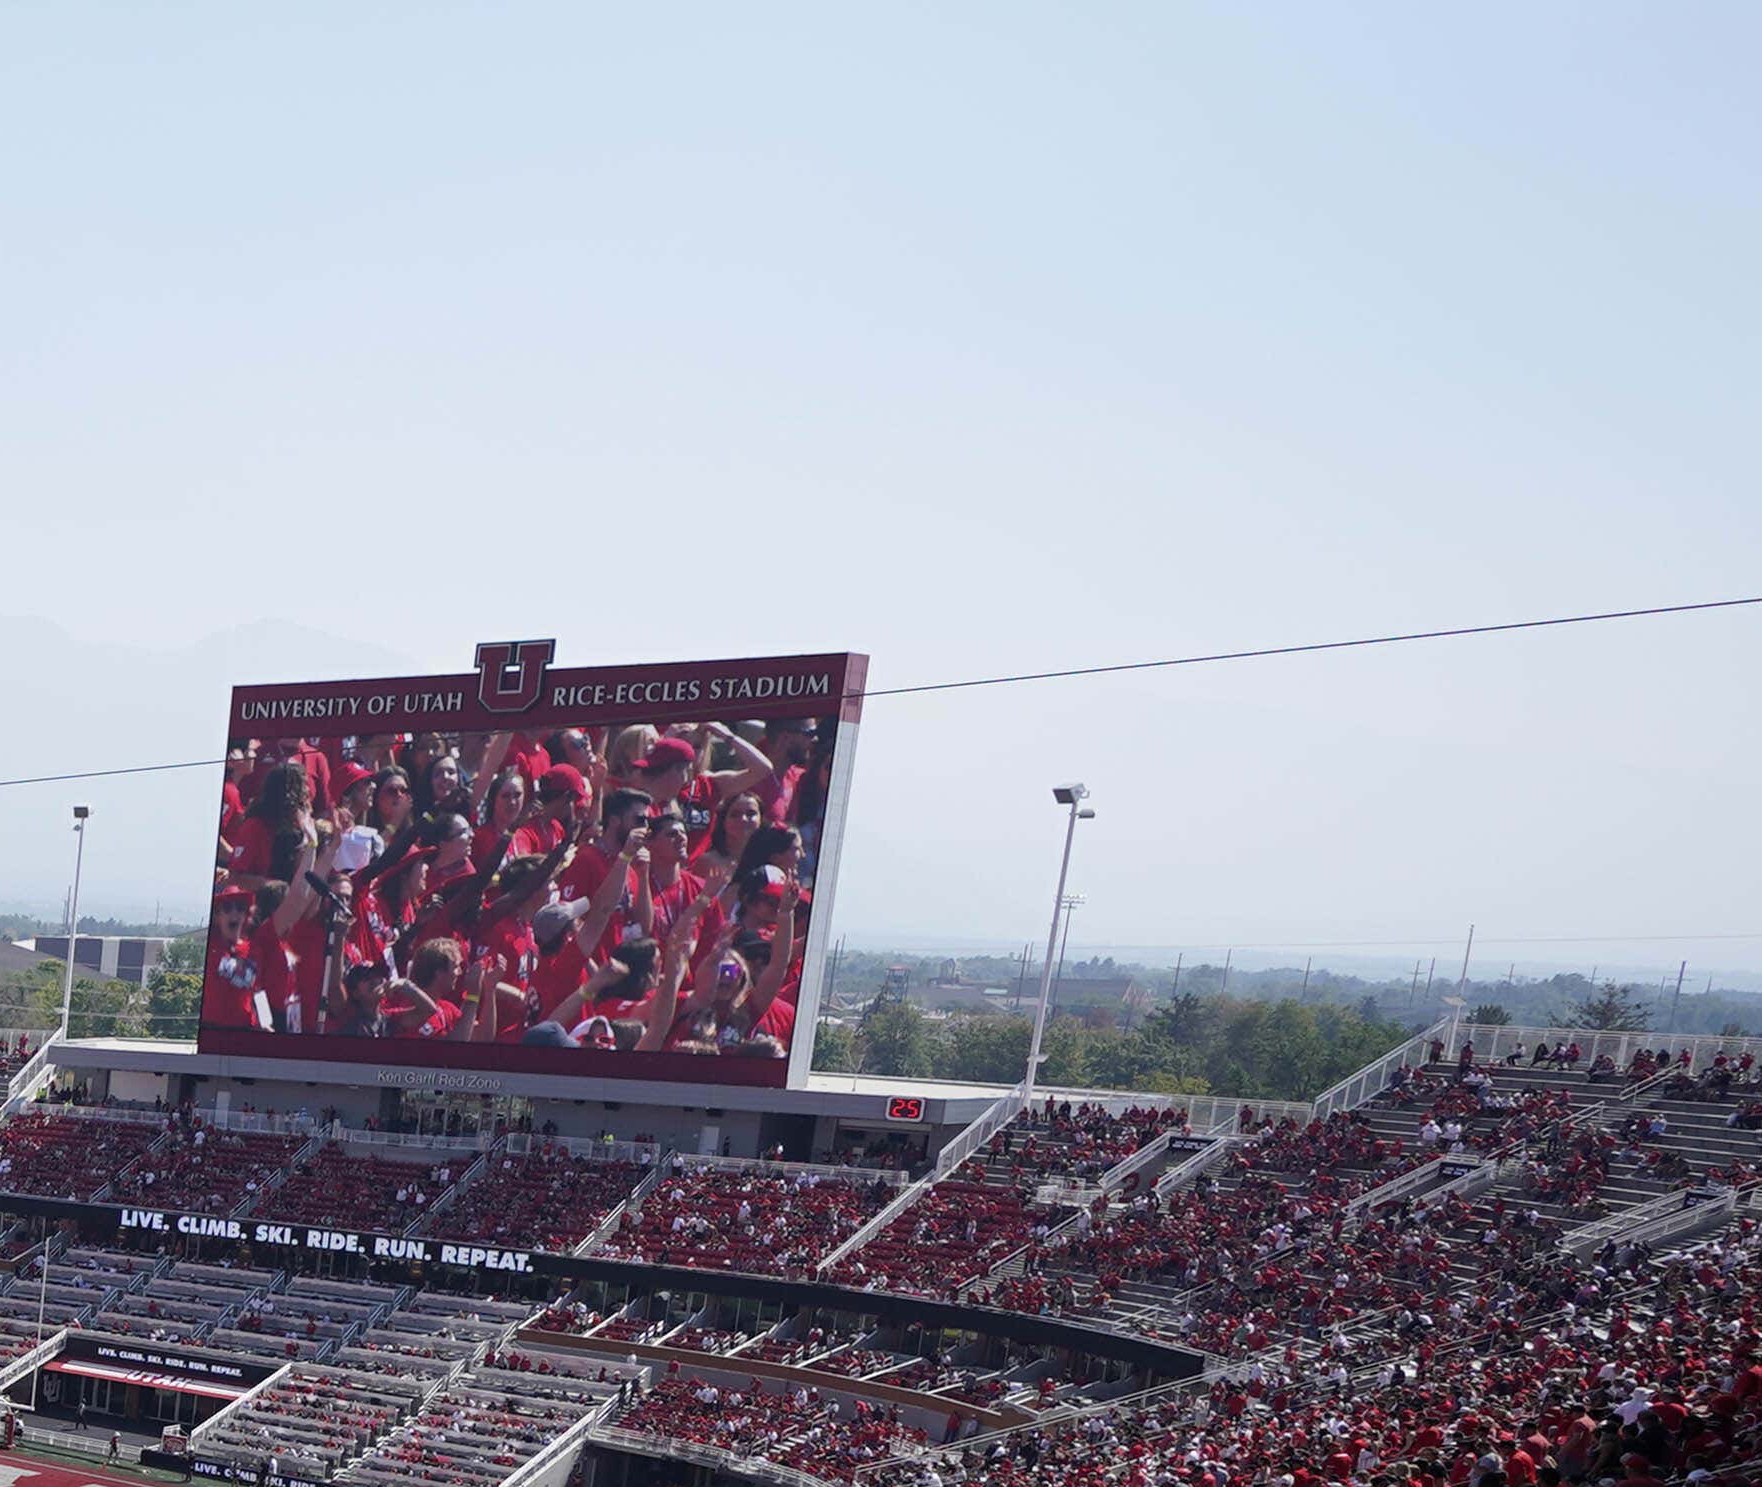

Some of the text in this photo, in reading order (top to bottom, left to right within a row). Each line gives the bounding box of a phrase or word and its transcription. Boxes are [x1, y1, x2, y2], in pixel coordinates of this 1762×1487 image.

[553, 673, 830, 707] RICE-ECCLES STADIUM
[241, 692, 464, 721] UNIVERSITY OF UTAH
[892, 1098, 919, 1118] 25
[120, 1209, 534, 1273] LIVE. CLIMB. SKI. RIDE. RUN. REPEAT.
[127, 1370, 191, 1388] UTAH
[194, 1461, 219, 1475] LIVE.
